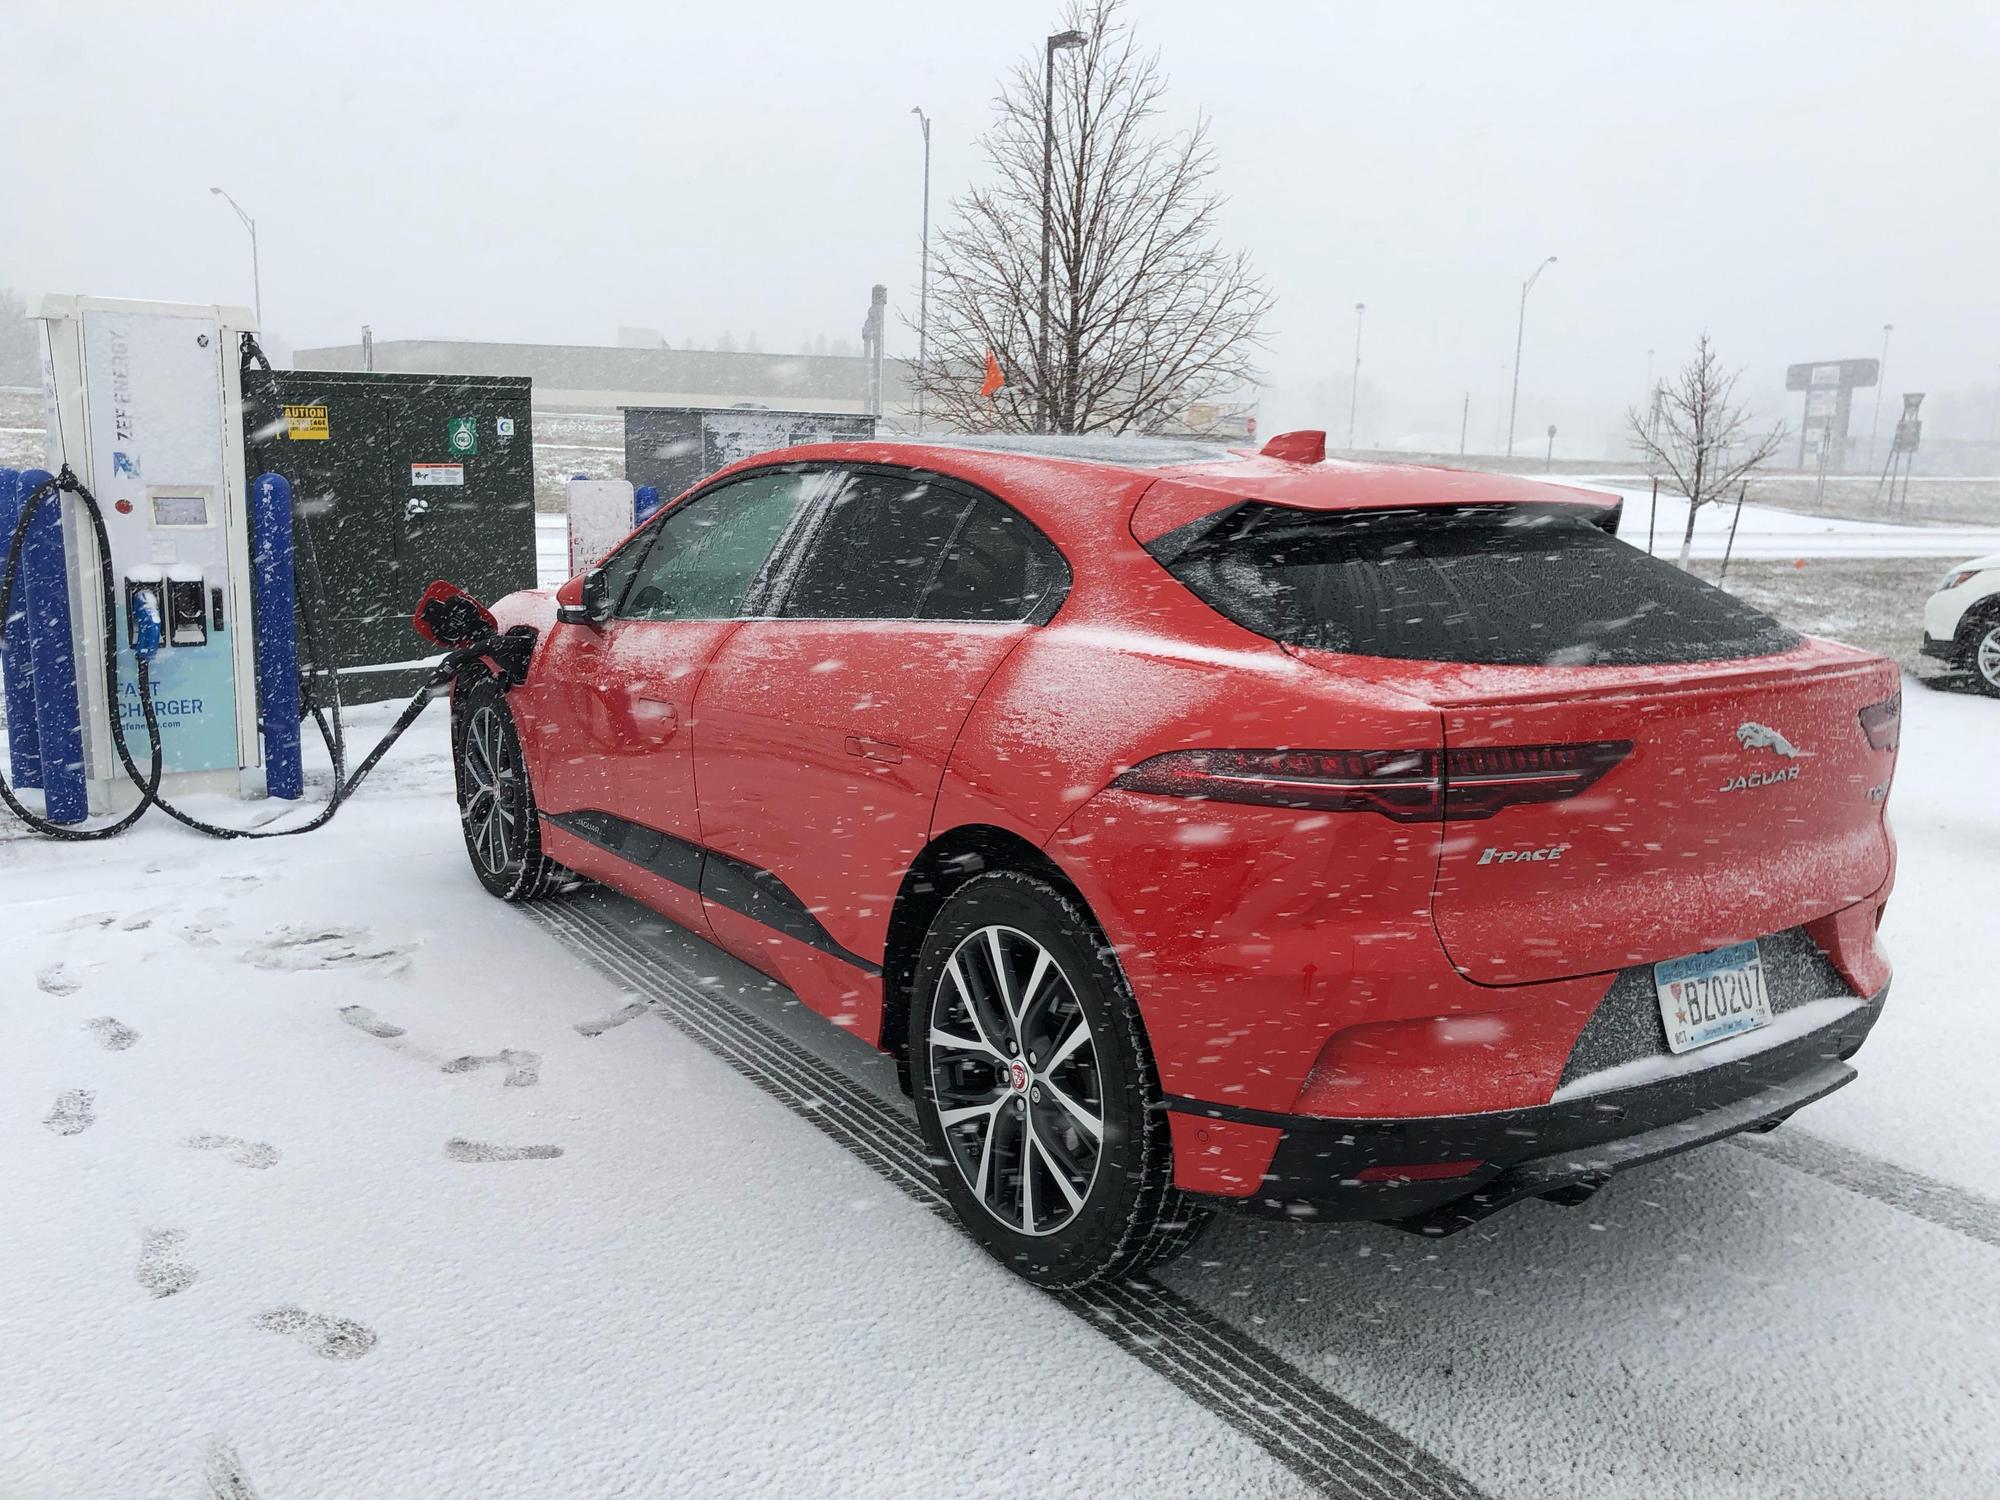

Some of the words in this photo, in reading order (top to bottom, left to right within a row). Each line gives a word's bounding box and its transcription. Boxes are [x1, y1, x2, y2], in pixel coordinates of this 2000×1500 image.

[284, 408, 325, 418] AUTION
[117, 681, 161, 698] FAT
[118, 699, 203, 718] CHRGER
[1719, 765, 1800, 793] JAGUAR
[1476, 847, 1566, 865] I-PACE
[1684, 964, 1761, 1026] BZ0207
